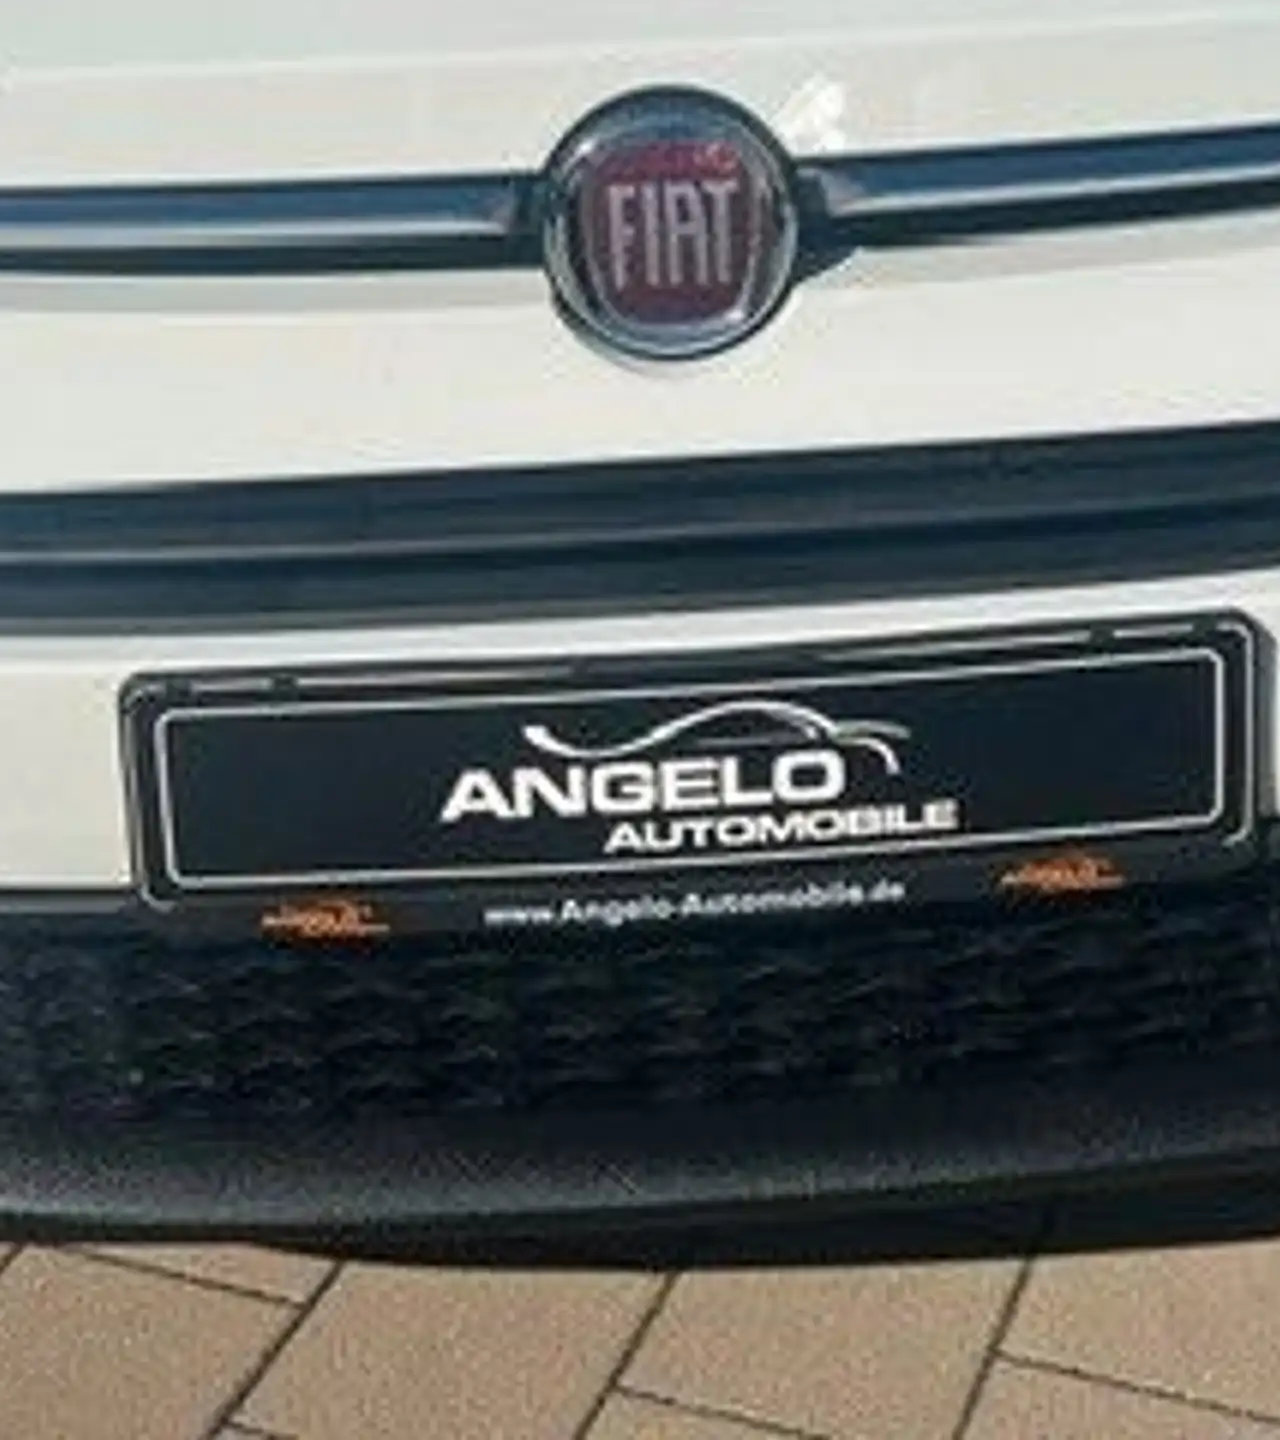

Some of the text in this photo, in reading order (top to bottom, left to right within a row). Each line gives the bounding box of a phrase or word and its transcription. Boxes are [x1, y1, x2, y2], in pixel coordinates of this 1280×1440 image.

[608, 176, 740, 291] FIAT
[440, 747, 847, 824] ANGELO
[603, 797, 960, 855] AUTOMOBILE
[483, 877, 906, 928] www.Angelo-Automobile.de
